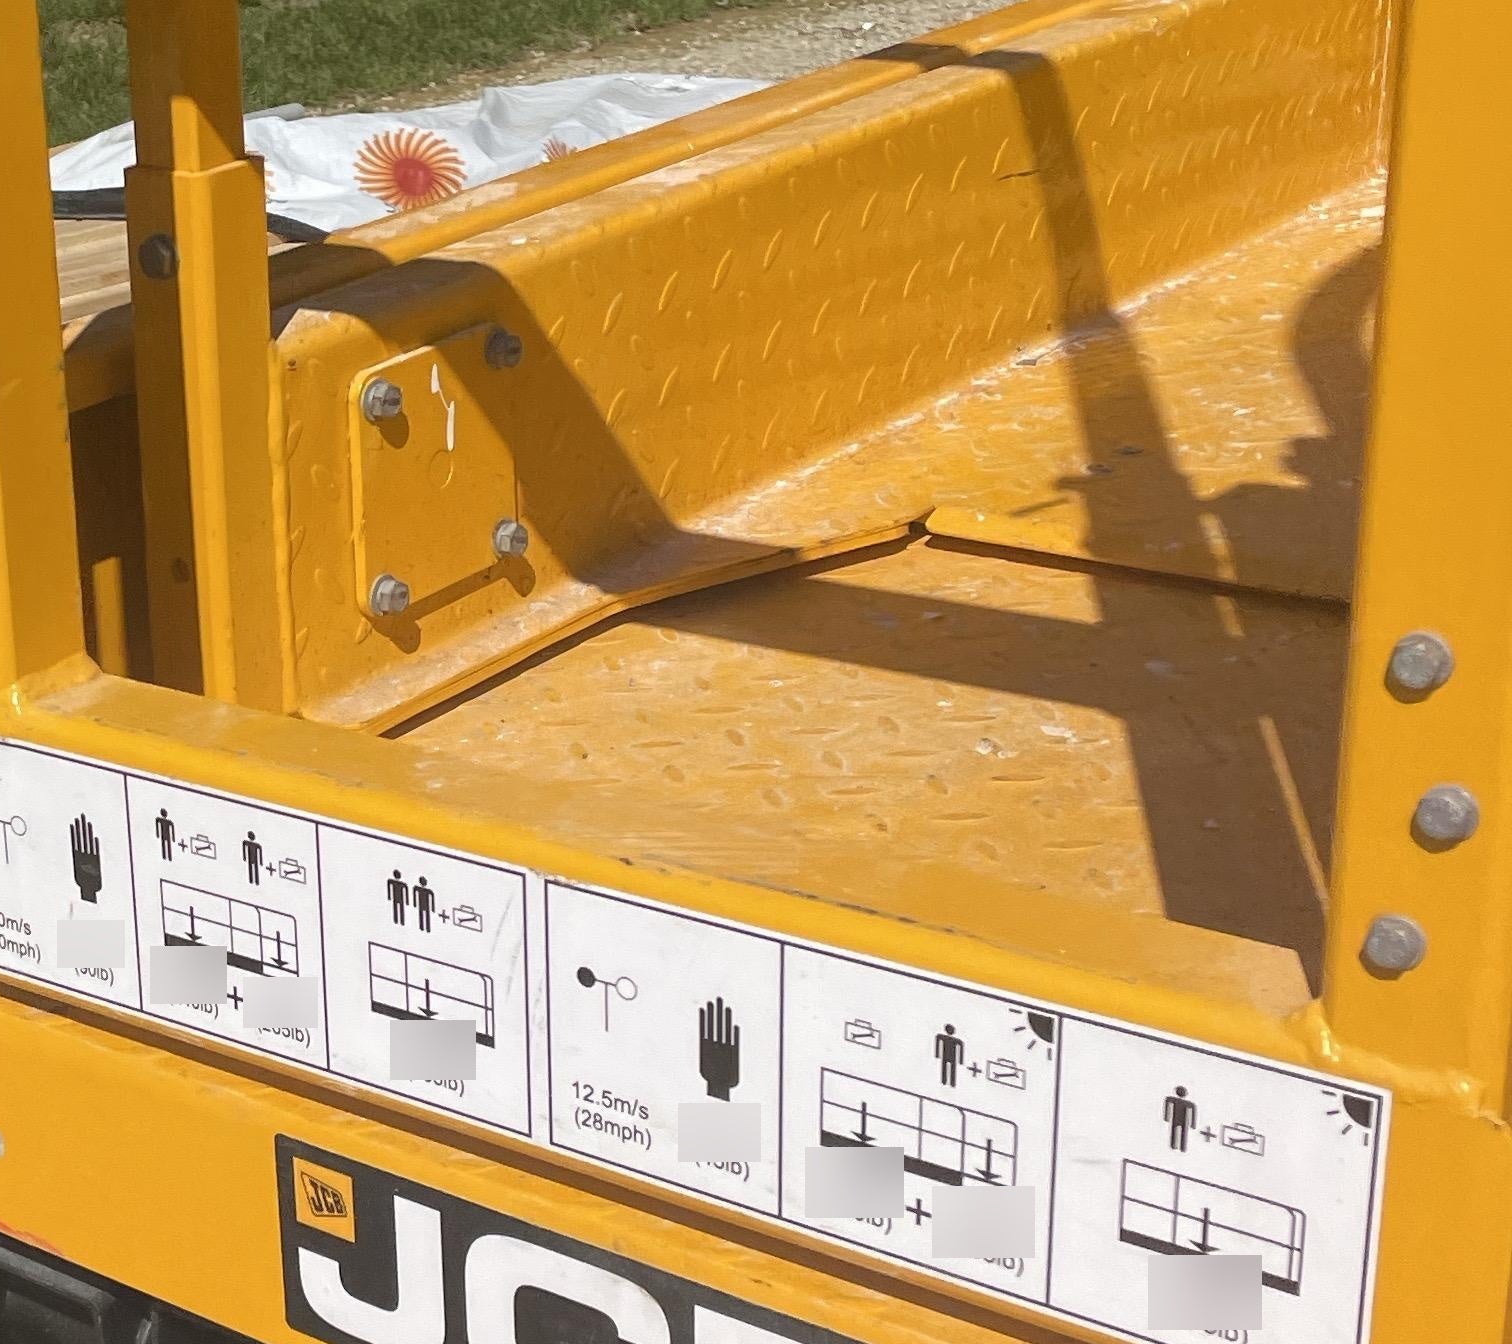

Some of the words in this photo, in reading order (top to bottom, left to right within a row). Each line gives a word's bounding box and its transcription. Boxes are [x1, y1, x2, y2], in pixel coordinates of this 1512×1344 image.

[571, 1080, 650, 1120] 12.5m/s
[574, 1106, 652, 1151] (28mph)
[308, 1177, 345, 1214] JCB
